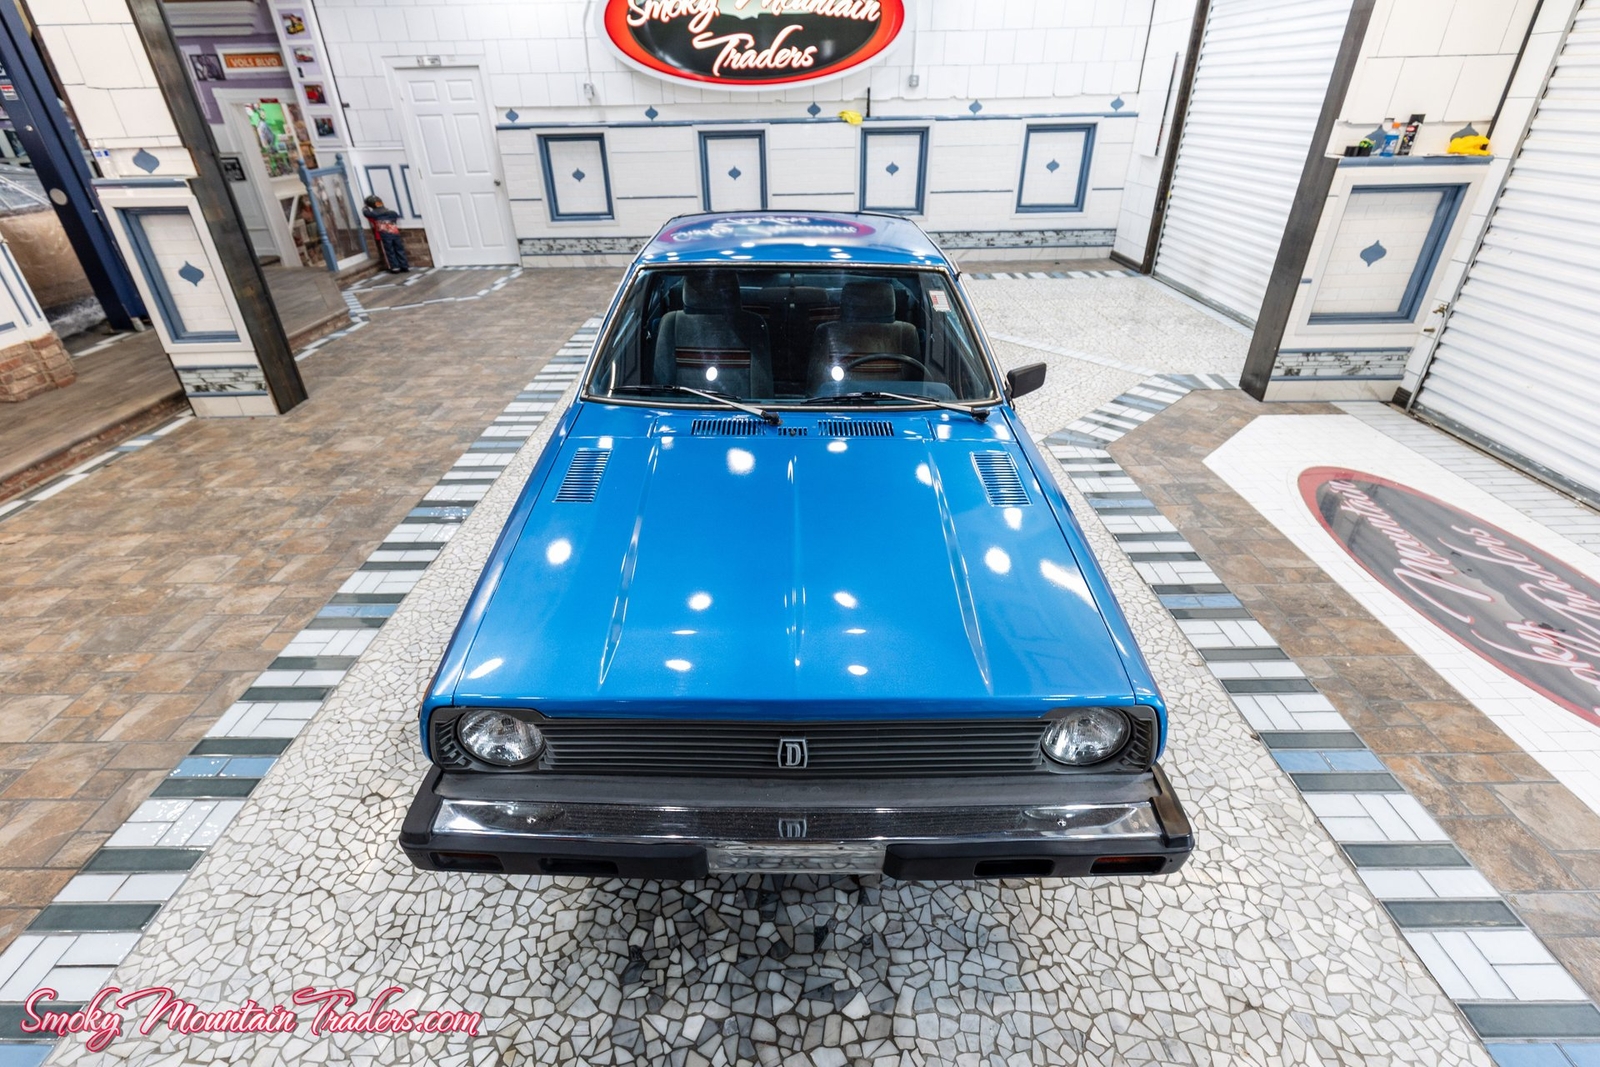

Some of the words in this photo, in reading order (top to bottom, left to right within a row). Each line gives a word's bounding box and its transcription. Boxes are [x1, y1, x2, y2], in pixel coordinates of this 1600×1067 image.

[230, 57, 254, 67] VOLS
[255, 56, 279, 67] BLVD
[692, 24, 818, 77] Traders
[785, 743, 801, 767] D
